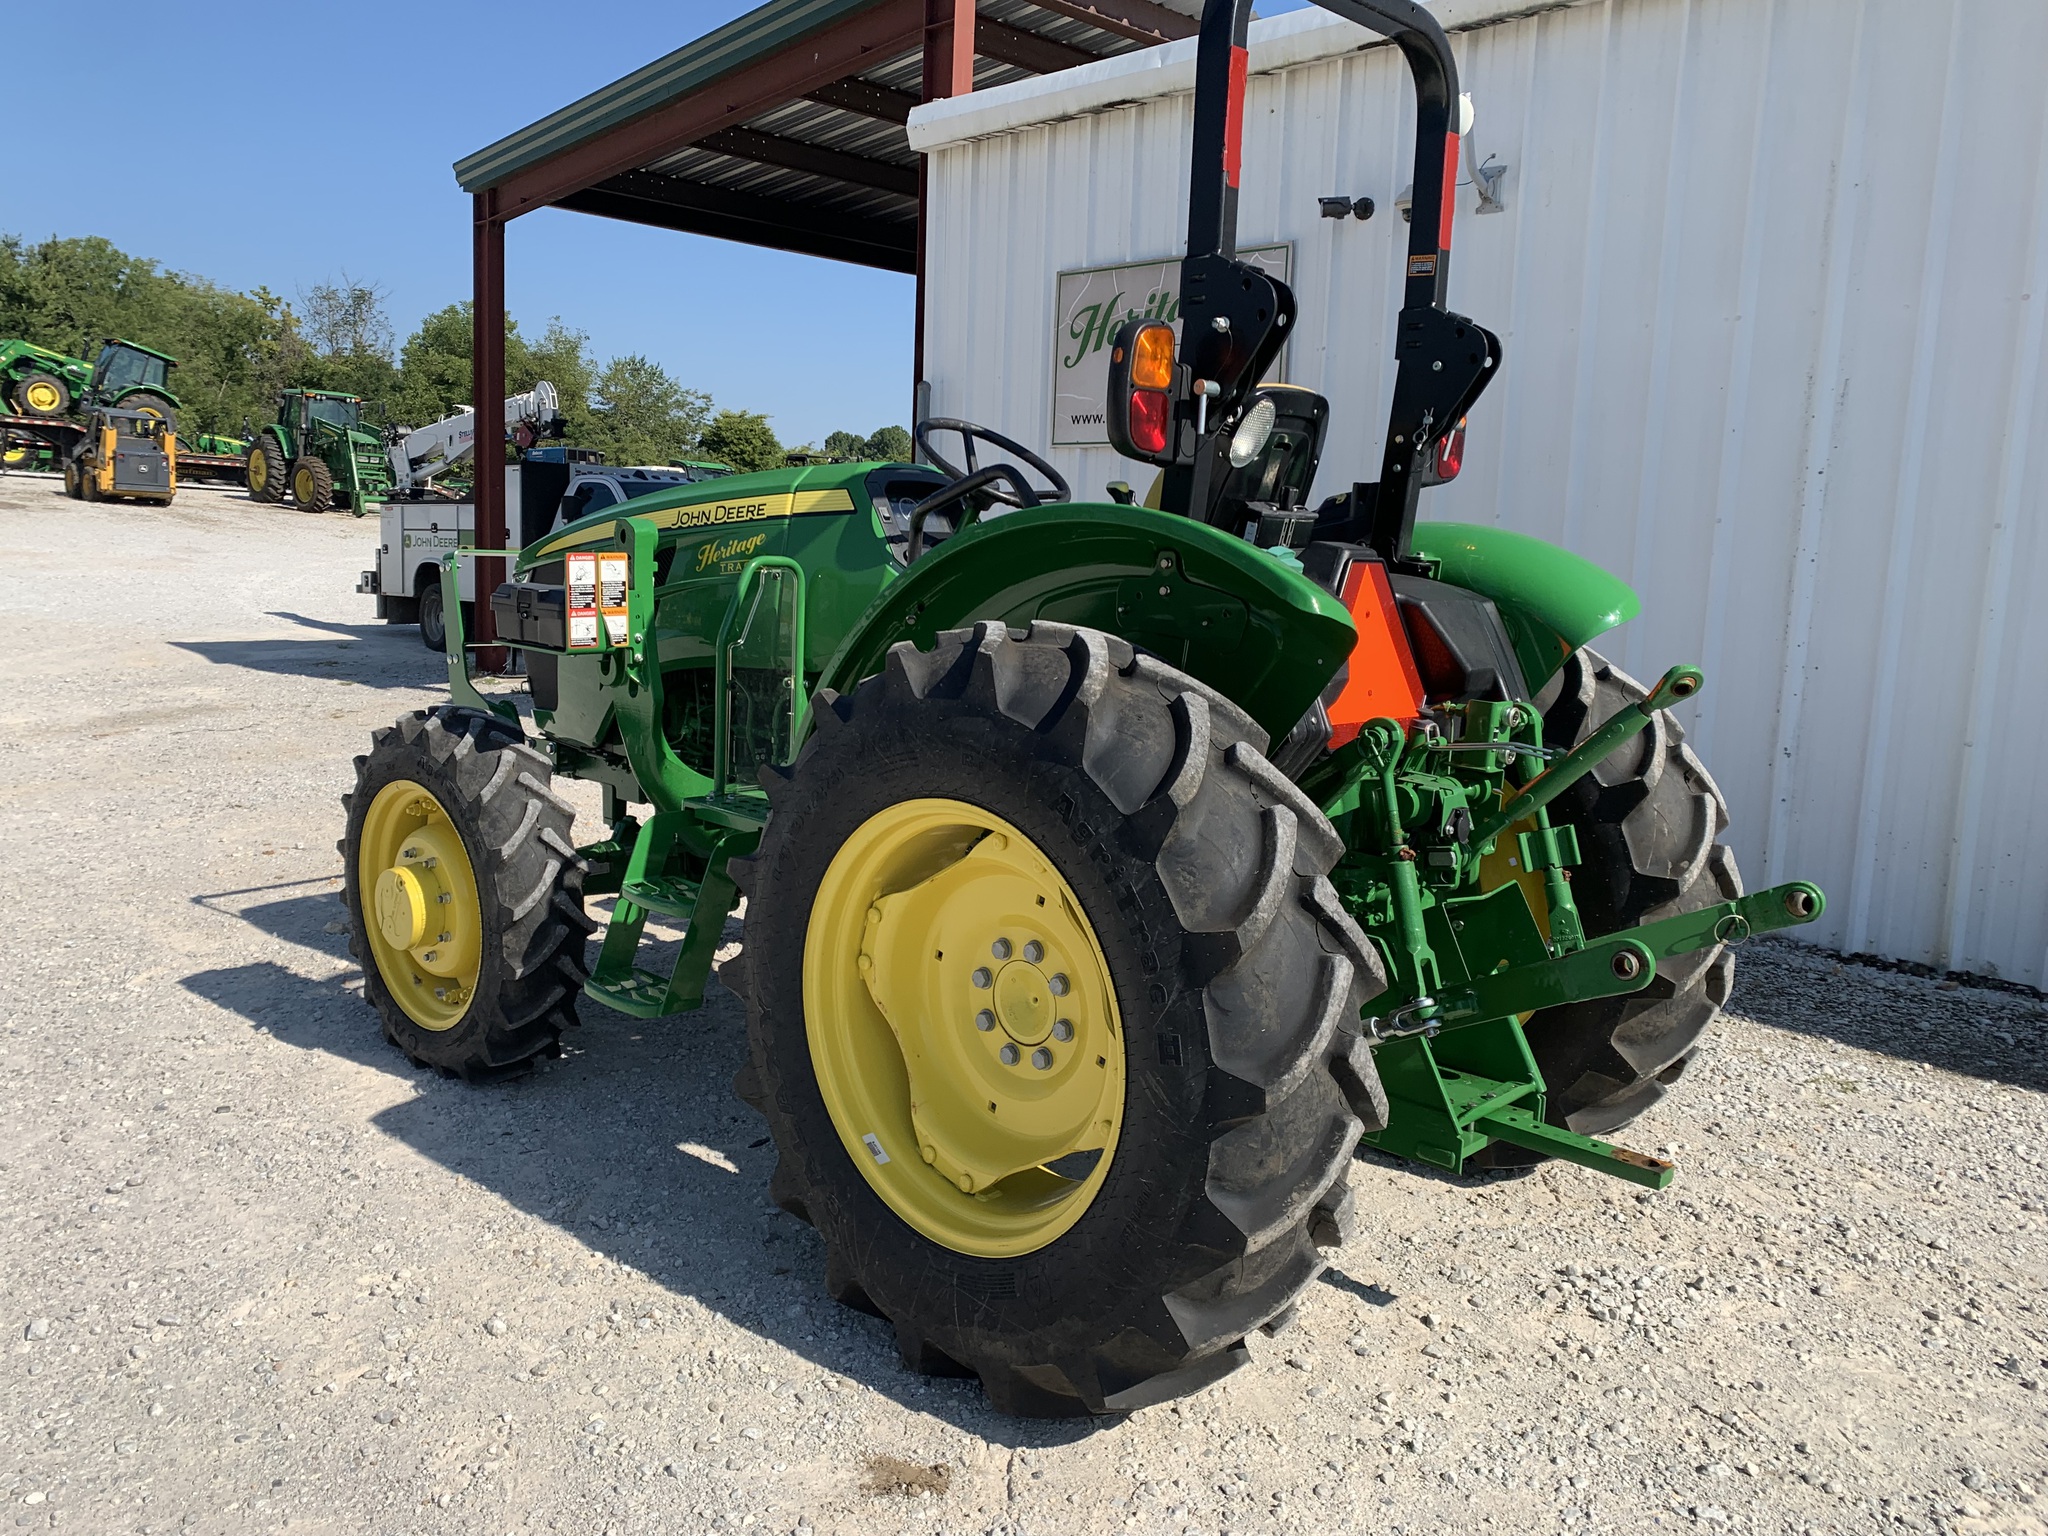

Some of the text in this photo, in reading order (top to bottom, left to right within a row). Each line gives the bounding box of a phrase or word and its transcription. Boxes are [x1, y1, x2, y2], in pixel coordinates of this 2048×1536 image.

[671, 503, 767, 526] JOHN DEERE
[413, 535, 458, 547] JOHN DEERE
[696, 533, 766, 572] Heritage
[720, 562, 749, 572] TRA
